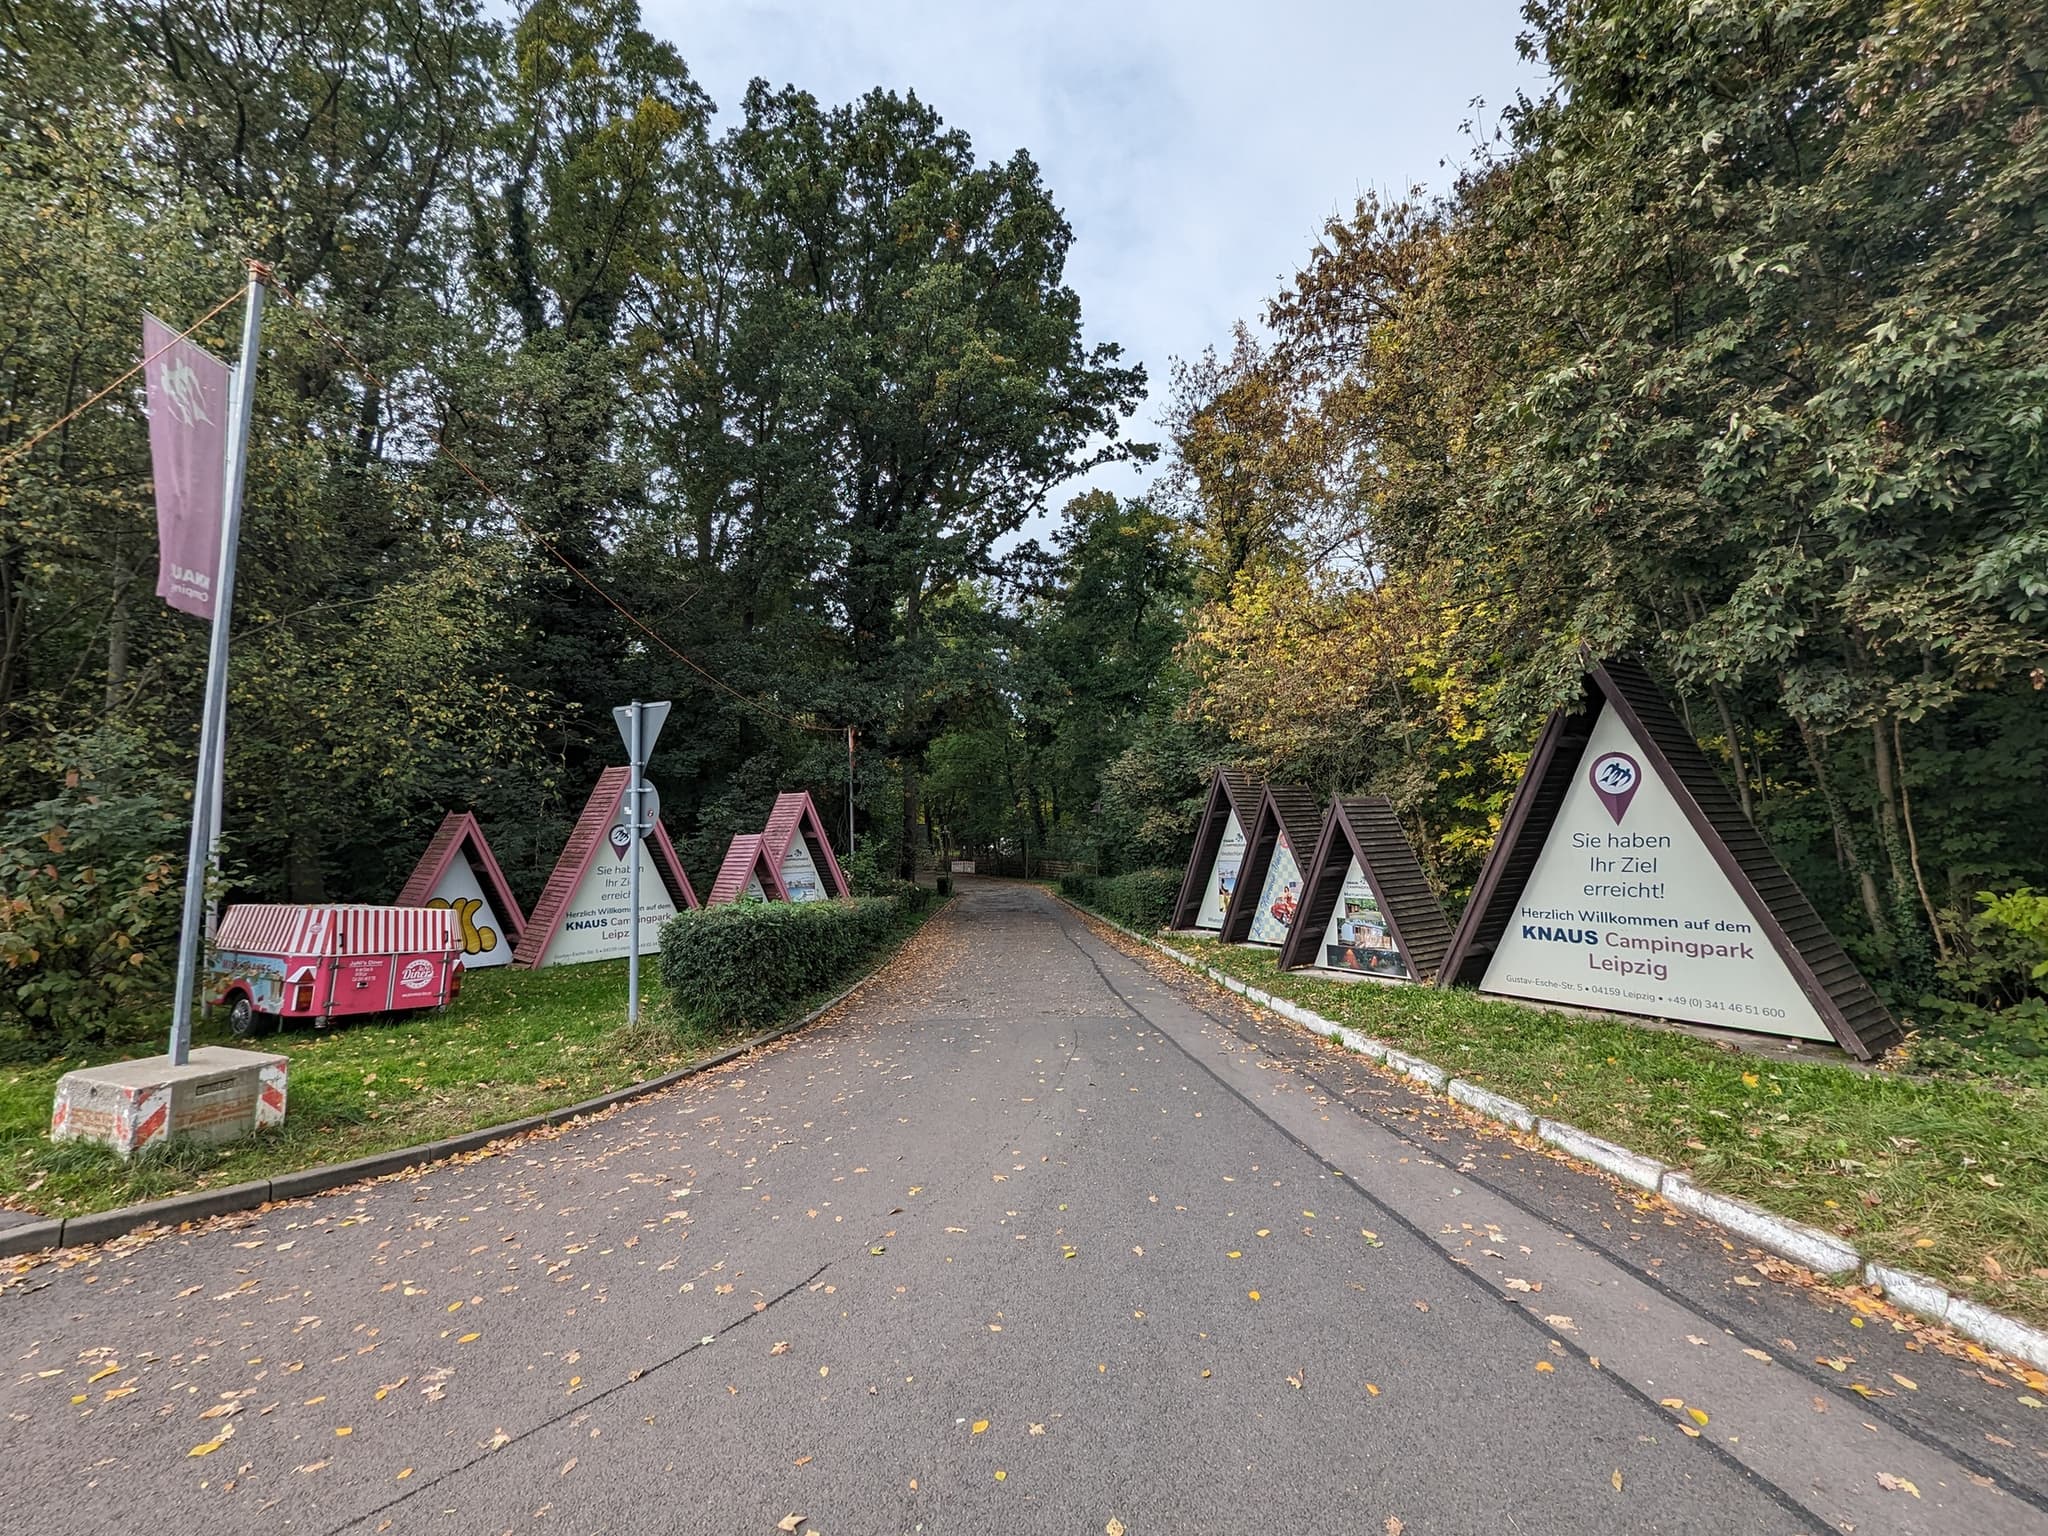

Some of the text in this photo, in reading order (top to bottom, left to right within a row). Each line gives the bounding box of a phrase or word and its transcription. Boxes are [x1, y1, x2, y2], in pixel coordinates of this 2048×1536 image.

[1572, 833, 1671, 848] Sie haben
[597, 866, 613, 875] Sie
[1590, 857, 1657, 873] Ihr Ziel
[605, 879, 618, 887] Ihr
[1583, 882, 1665, 899] erreicht!
[566, 907, 597, 919] Herzlich
[1521, 907, 1751, 934] Herzlich Willkommen auf dem
[566, 918, 608, 931] KNAUS
[602, 930, 630, 940] Leipz
[1522, 925, 1755, 960] KNAUS Campingpark
[402, 967, 432, 980] Diner
[1589, 953, 1668, 981] Leipzig
[1506, 974, 1786, 1019] Gustav-Esche-Str. 5 04159 Leipzig +49 (0) 341 46 51 600
